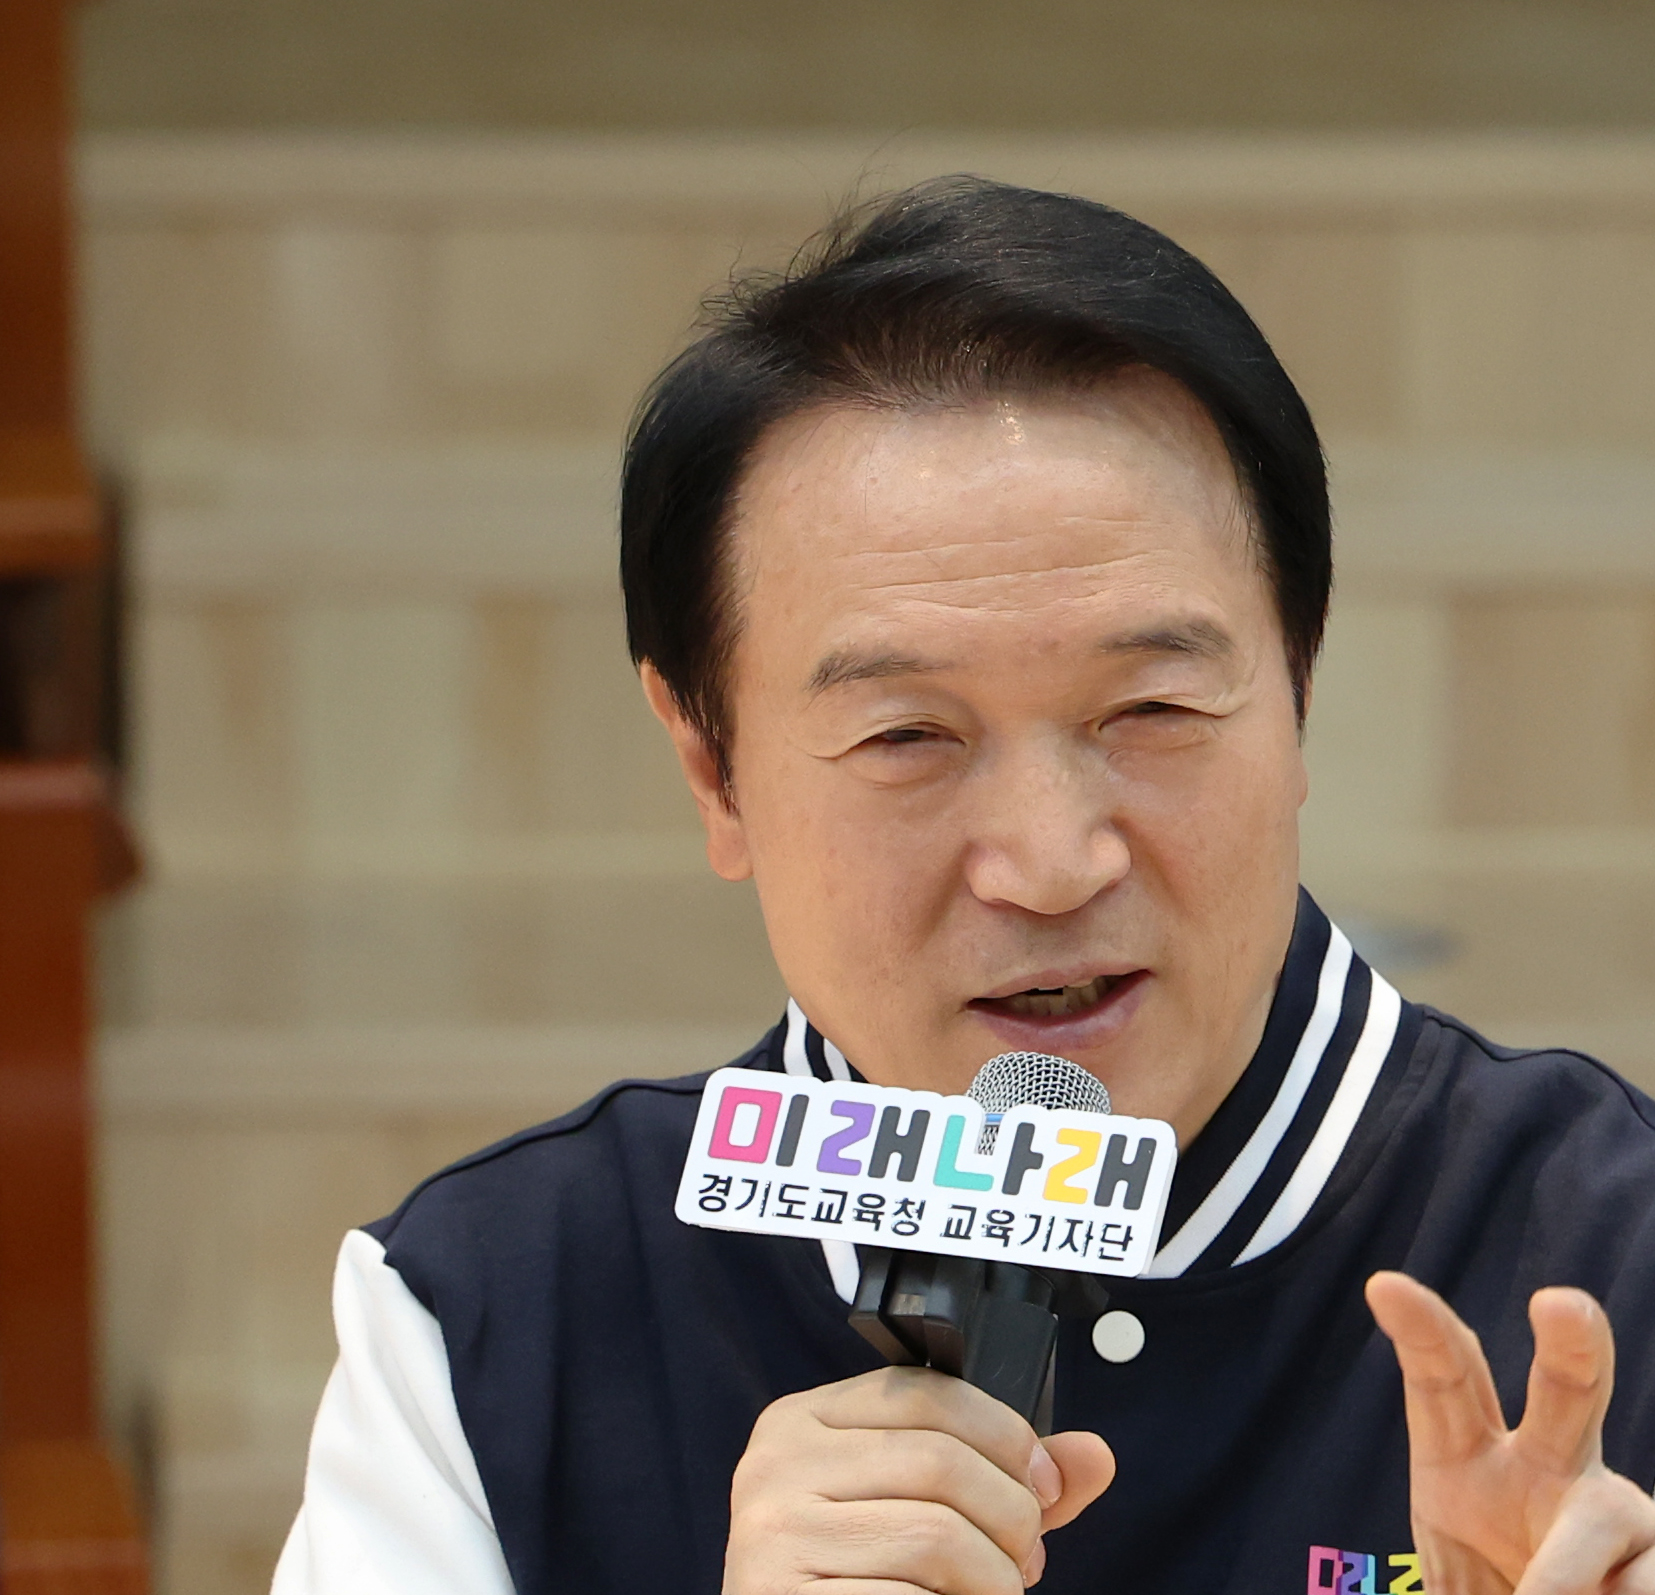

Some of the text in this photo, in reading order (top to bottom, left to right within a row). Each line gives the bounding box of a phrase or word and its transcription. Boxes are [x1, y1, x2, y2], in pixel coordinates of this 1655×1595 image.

[707, 1085, 1157, 1210] 미래나래
[697, 1173, 1134, 1262] 경기도교육청 교육기자단
